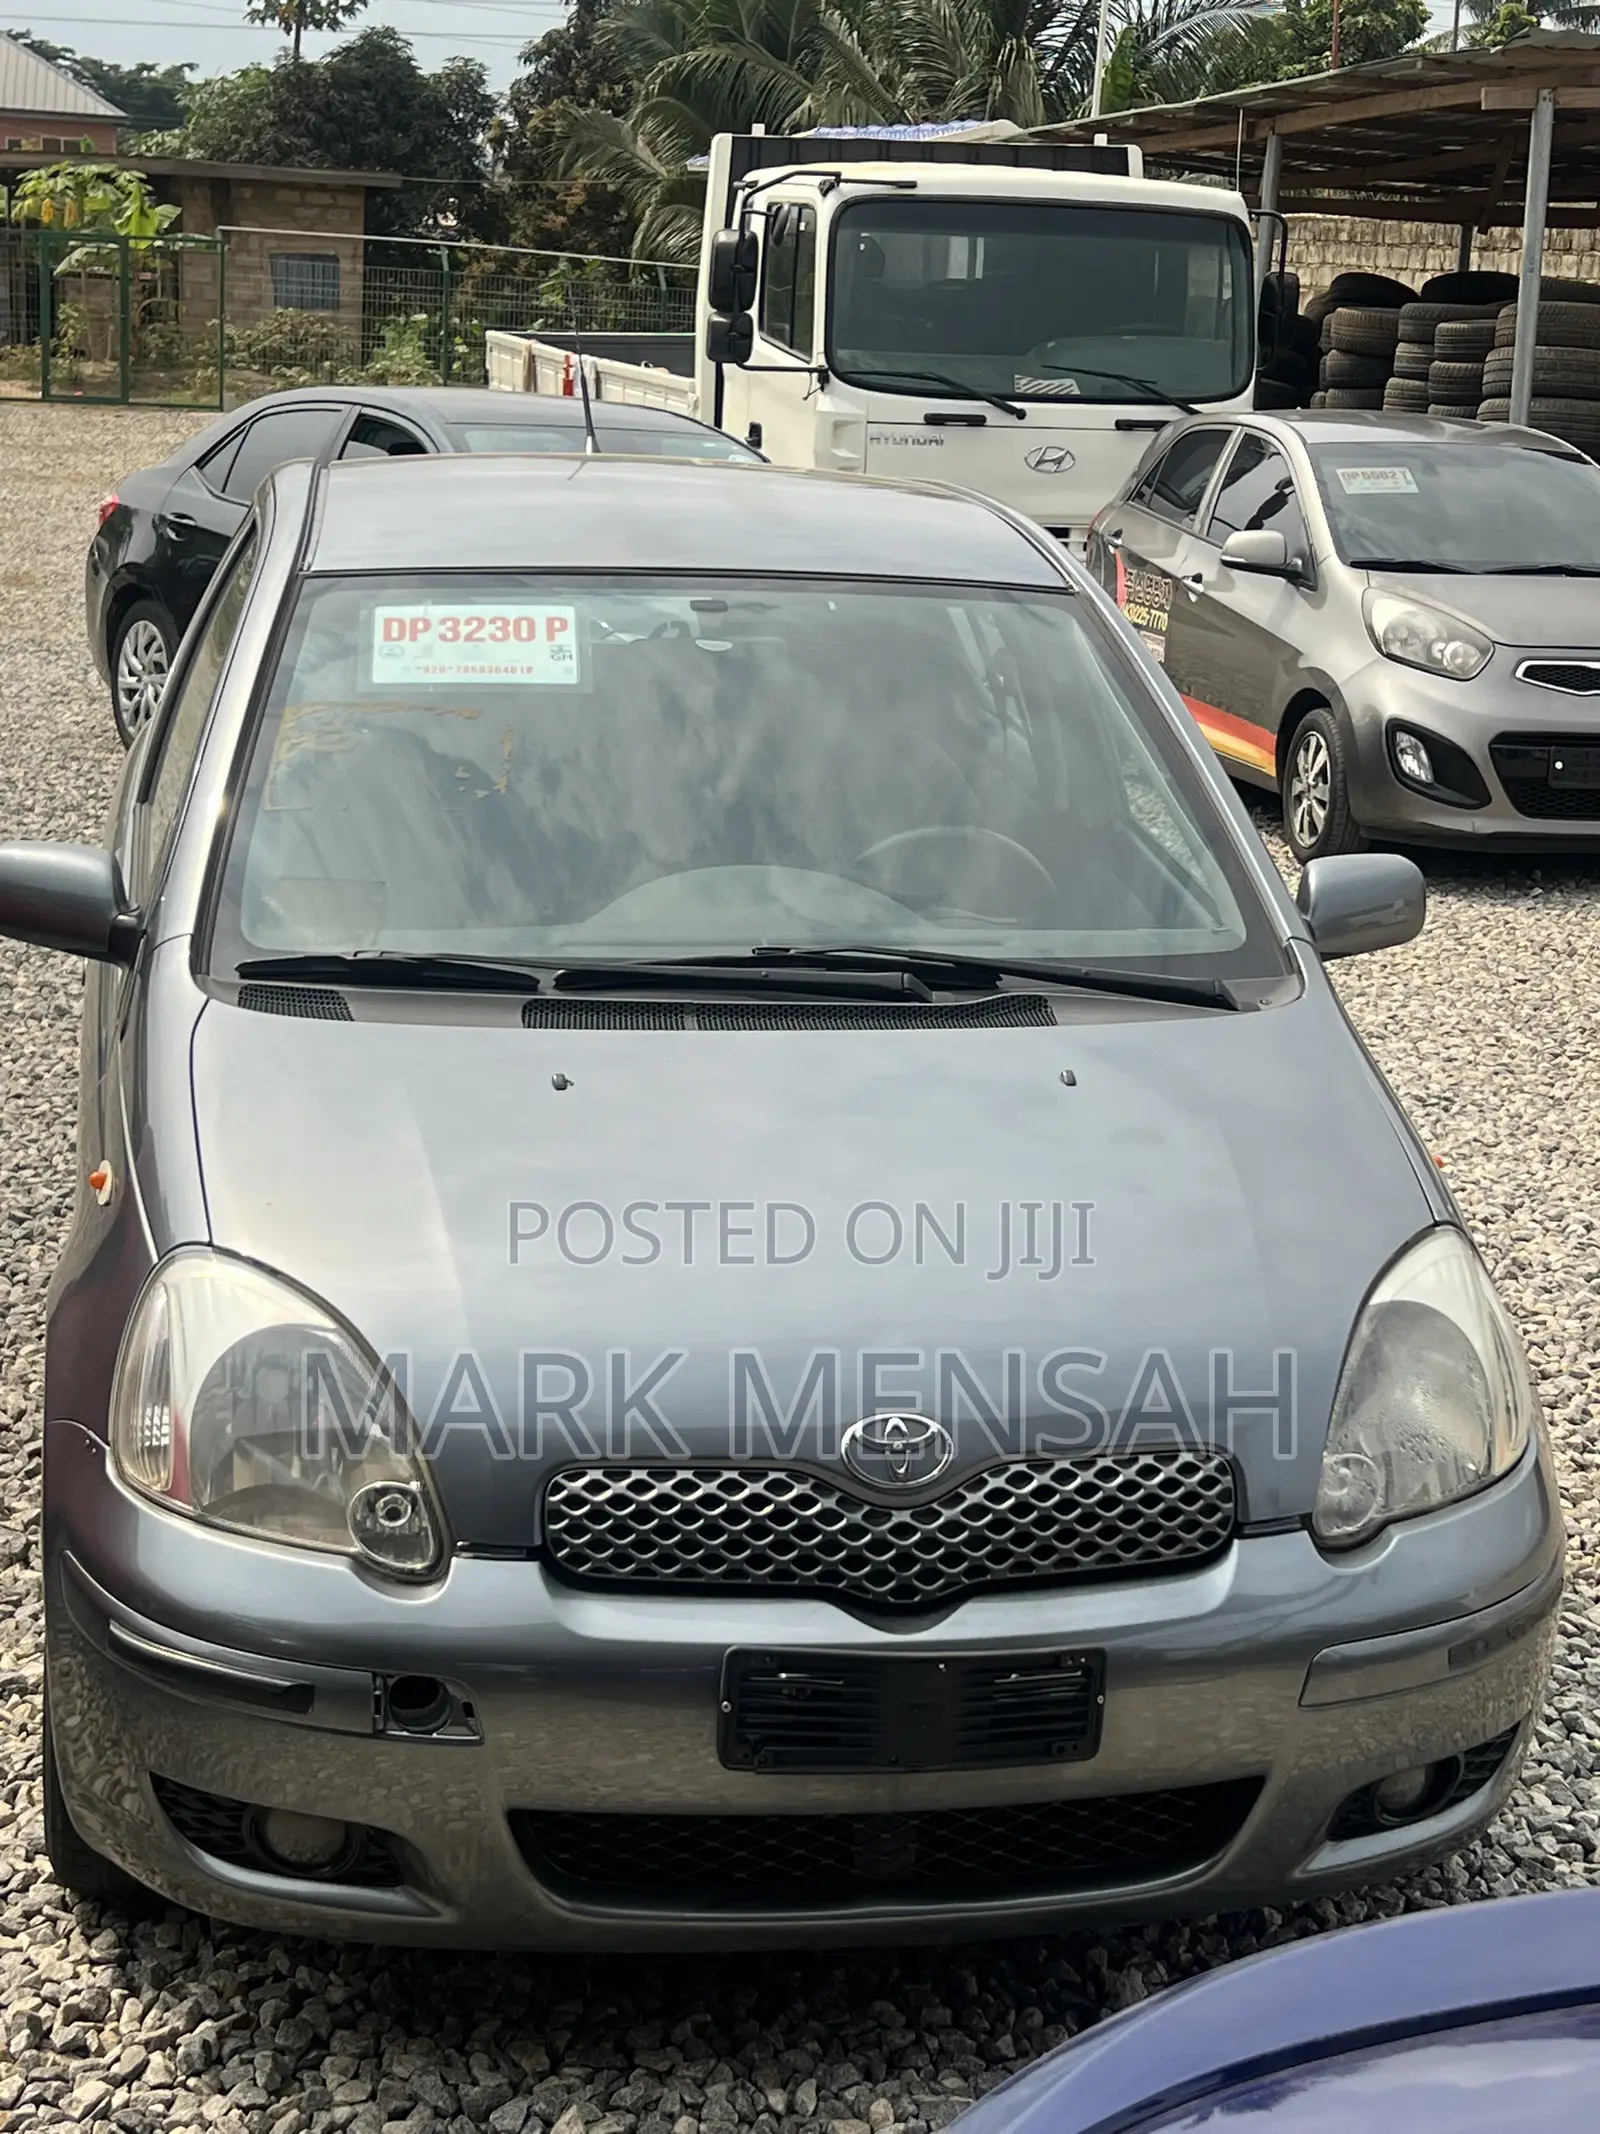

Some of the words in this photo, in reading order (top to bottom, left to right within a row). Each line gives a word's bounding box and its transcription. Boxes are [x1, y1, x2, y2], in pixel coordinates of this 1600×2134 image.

[869, 432, 945, 446] HYUNDAI
[382, 617, 432, 643] DP
[438, 616, 536, 643] 3230
[545, 616, 569, 643] P
[550, 653, 574, 661] GH
